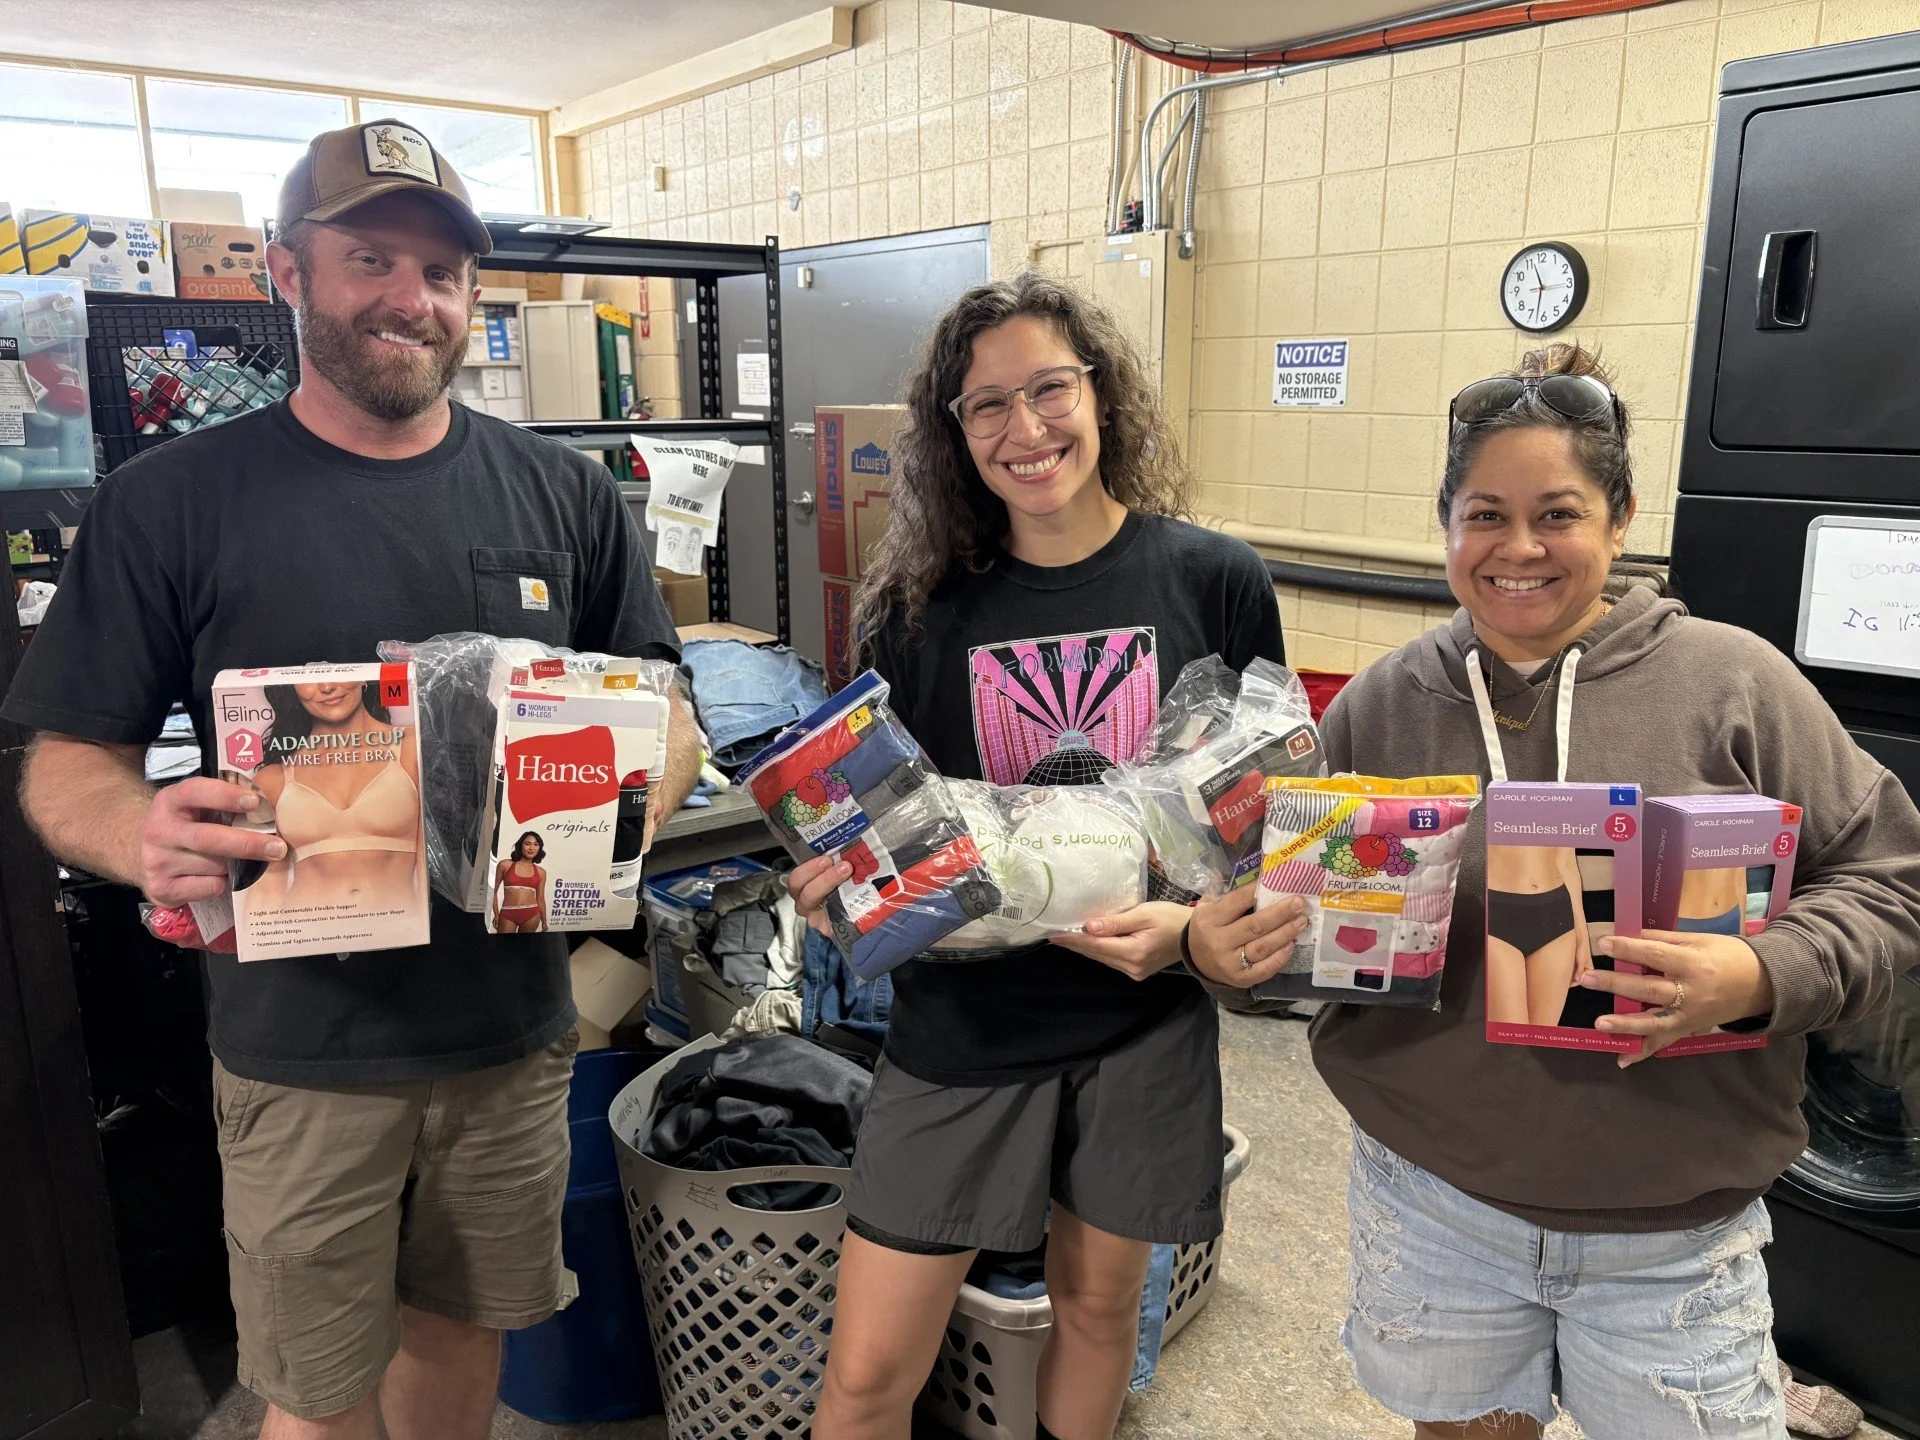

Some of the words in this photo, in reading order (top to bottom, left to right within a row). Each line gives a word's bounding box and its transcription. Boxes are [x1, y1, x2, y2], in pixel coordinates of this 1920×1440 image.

[125, 231, 149, 240] best
[129, 241, 158, 250] snack
[127, 250, 154, 258] ever
[1537, 253, 1547, 263] 12
[1553, 254, 1557, 265] 1
[1526, 259, 1533, 270] 11
[1562, 264, 1569, 274] 2
[1515, 272, 1525, 282] 10
[1566, 278, 1573, 288] 3
[187, 280, 258, 298] organic
[1514, 286, 1520, 297] 9
[1562, 293, 1569, 304] 4
[1518, 300, 1525, 311] 8
[1553, 306, 1560, 316] 5
[1528, 309, 1534, 320] 7
[1540, 311, 1547, 322] 6
[1279, 345, 1344, 364] NOTICE
[1278, 372, 1293, 385] NO
[1294, 372, 1342, 385] STORAGE
[1281, 387, 1337, 399] PERMITTED
[653, 447, 684, 455] CLEAN
[684, 447, 718, 465] CLOTHES
[692, 463, 709, 478] HERE
[825, 420, 843, 511] small
[667, 493, 677, 506] TO
[680, 498, 691, 510] PUT
[535, 663, 562, 673] Hanes
[387, 685, 402, 698] M
[217, 694, 273, 723] Felina
[516, 703, 527, 717] 6
[528, 704, 558, 712] WOMEN'S
[527, 711, 552, 719] HI-LEGS
[234, 733, 254, 757] 2
[269, 732, 361, 752] ADAPTIVE
[365, 727, 405, 745] CUP
[1295, 737, 1305, 749] M
[281, 755, 320, 766] WIRE
[326, 752, 360, 764] FREE
[365, 749, 395, 763] BRA
[515, 754, 610, 784] Hanes
[1203, 784, 1212, 795] 3
[1216, 793, 1267, 826] Hanes
[804, 821, 828, 841] FRUIT
[833, 805, 858, 824] LOOM
[1417, 817, 1432, 828] 12
[1614, 816, 1627, 833] 5
[1694, 819, 1720, 827] CAROLE
[546, 820, 611, 838] originals
[1493, 822, 1558, 835] Seamless
[1561, 823, 1598, 836] Brief
[1053, 833, 1132, 849] Women's
[1280, 836, 1310, 858] SUPER
[1306, 817, 1336, 843] VALUE
[1779, 835, 1789, 850] 5
[814, 841, 826, 851] 7
[1657, 828, 1667, 860] CAROLE
[1691, 845, 1739, 858] Seamless
[1742, 843, 1769, 855] Brief
[1243, 863, 1250, 871] 3
[555, 878, 563, 889] 6
[564, 881, 595, 889] WOMEN'S
[1327, 880, 1359, 890] FRUIT
[1369, 882, 1401, 891] LOOM
[1652, 863, 1662, 903] HOCHMAN
[553, 889, 601, 899] COTTON
[1323, 893, 1341, 906] 14
[552, 899, 606, 909] STRETCH
[279, 907, 313, 915] Comfortable
[551, 908, 589, 917] HI-LEGS
[342, 932, 373, 940] Appearance
